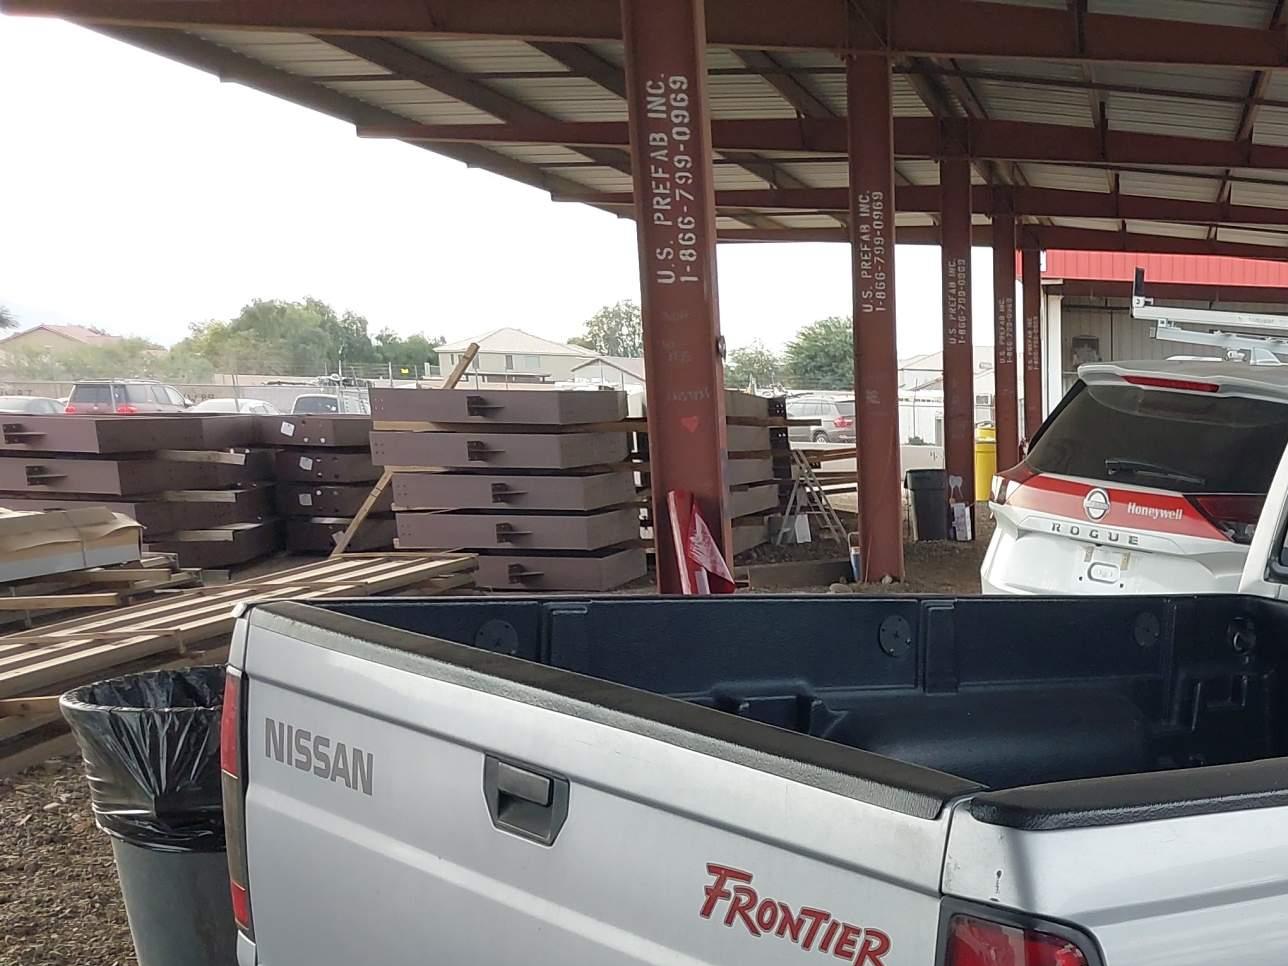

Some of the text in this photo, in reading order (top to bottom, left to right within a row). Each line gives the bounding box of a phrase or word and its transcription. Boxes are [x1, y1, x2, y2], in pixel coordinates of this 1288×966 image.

[645, 72, 669, 119] INC.
[648, 132, 673, 226] PREFAB
[668, 74, 699, 283] 1-866-799-0969
[656, 240, 678, 285] U.S.
[857, 189, 874, 314] U.S. PREFAB INC.
[871, 191, 887, 312] 1-866-799-0969
[1050, 521, 1140, 546] ROGUE
[1127, 501, 1184, 521] Honeywell
[264, 717, 374, 796] NISSAN
